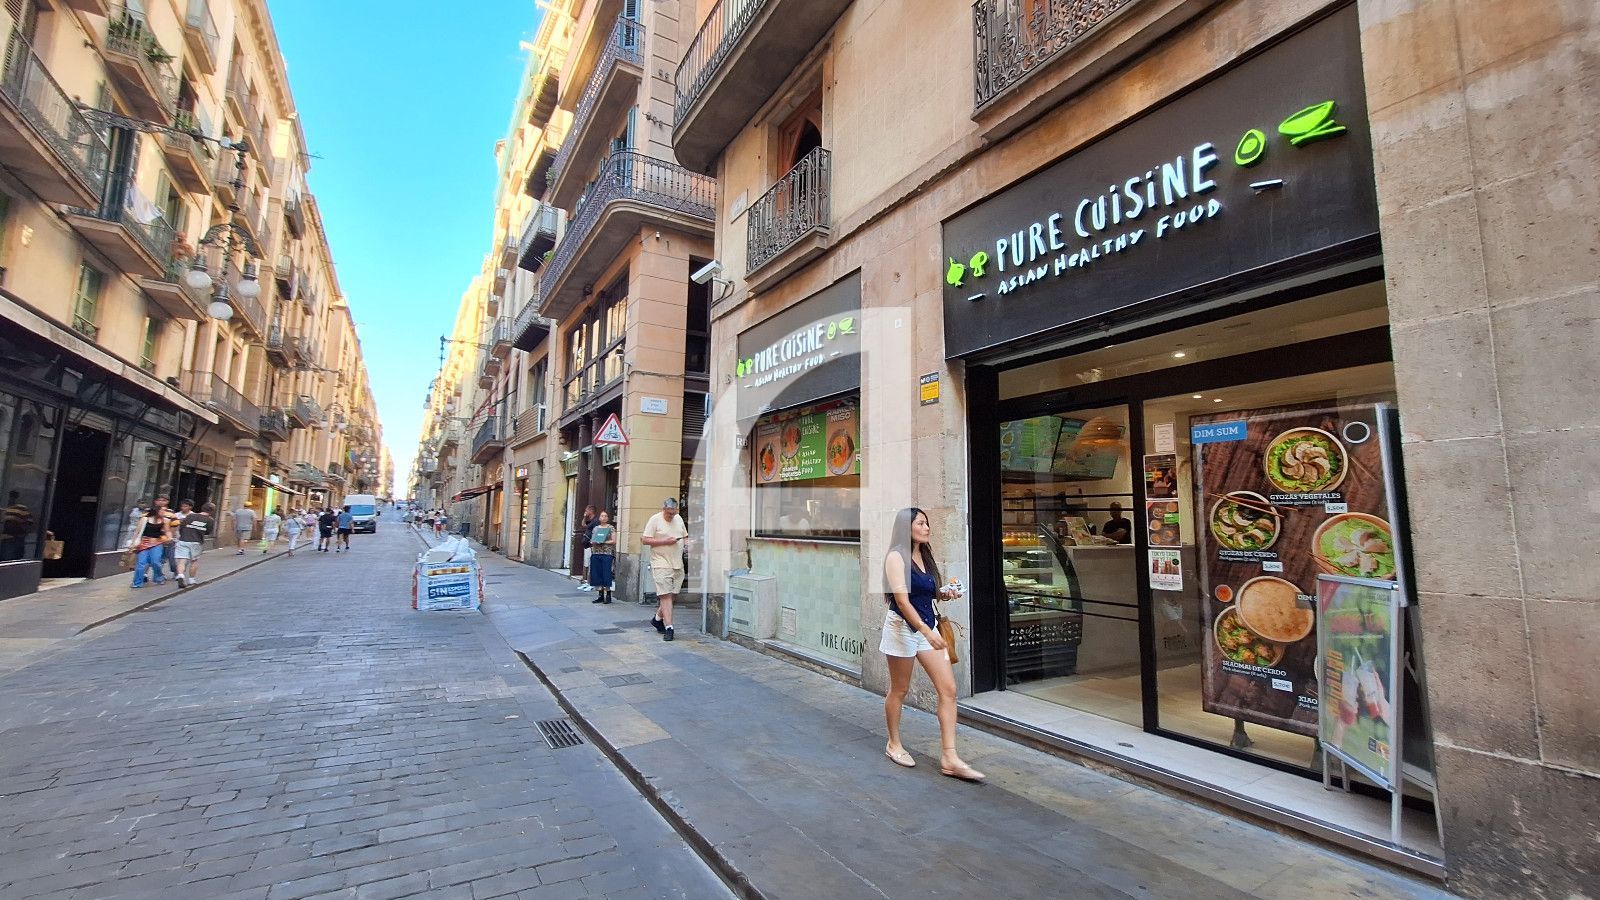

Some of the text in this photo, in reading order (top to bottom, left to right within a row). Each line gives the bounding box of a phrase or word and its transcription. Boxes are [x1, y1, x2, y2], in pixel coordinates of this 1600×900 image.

[996, 212, 1065, 272] PURE
[997, 264, 1050, 295] ASIAN
[1156, 198, 1223, 238] FOOD
[754, 343, 779, 374] PURE
[754, 372, 773, 387] ASIAN
[804, 354, 825, 370] FOOD
[830, 411, 851, 423] MISO
[1193, 426, 1239, 439] DIM SUM
[820, 631, 838, 650] PURE
[1262, 667, 1287, 677] CERDO
